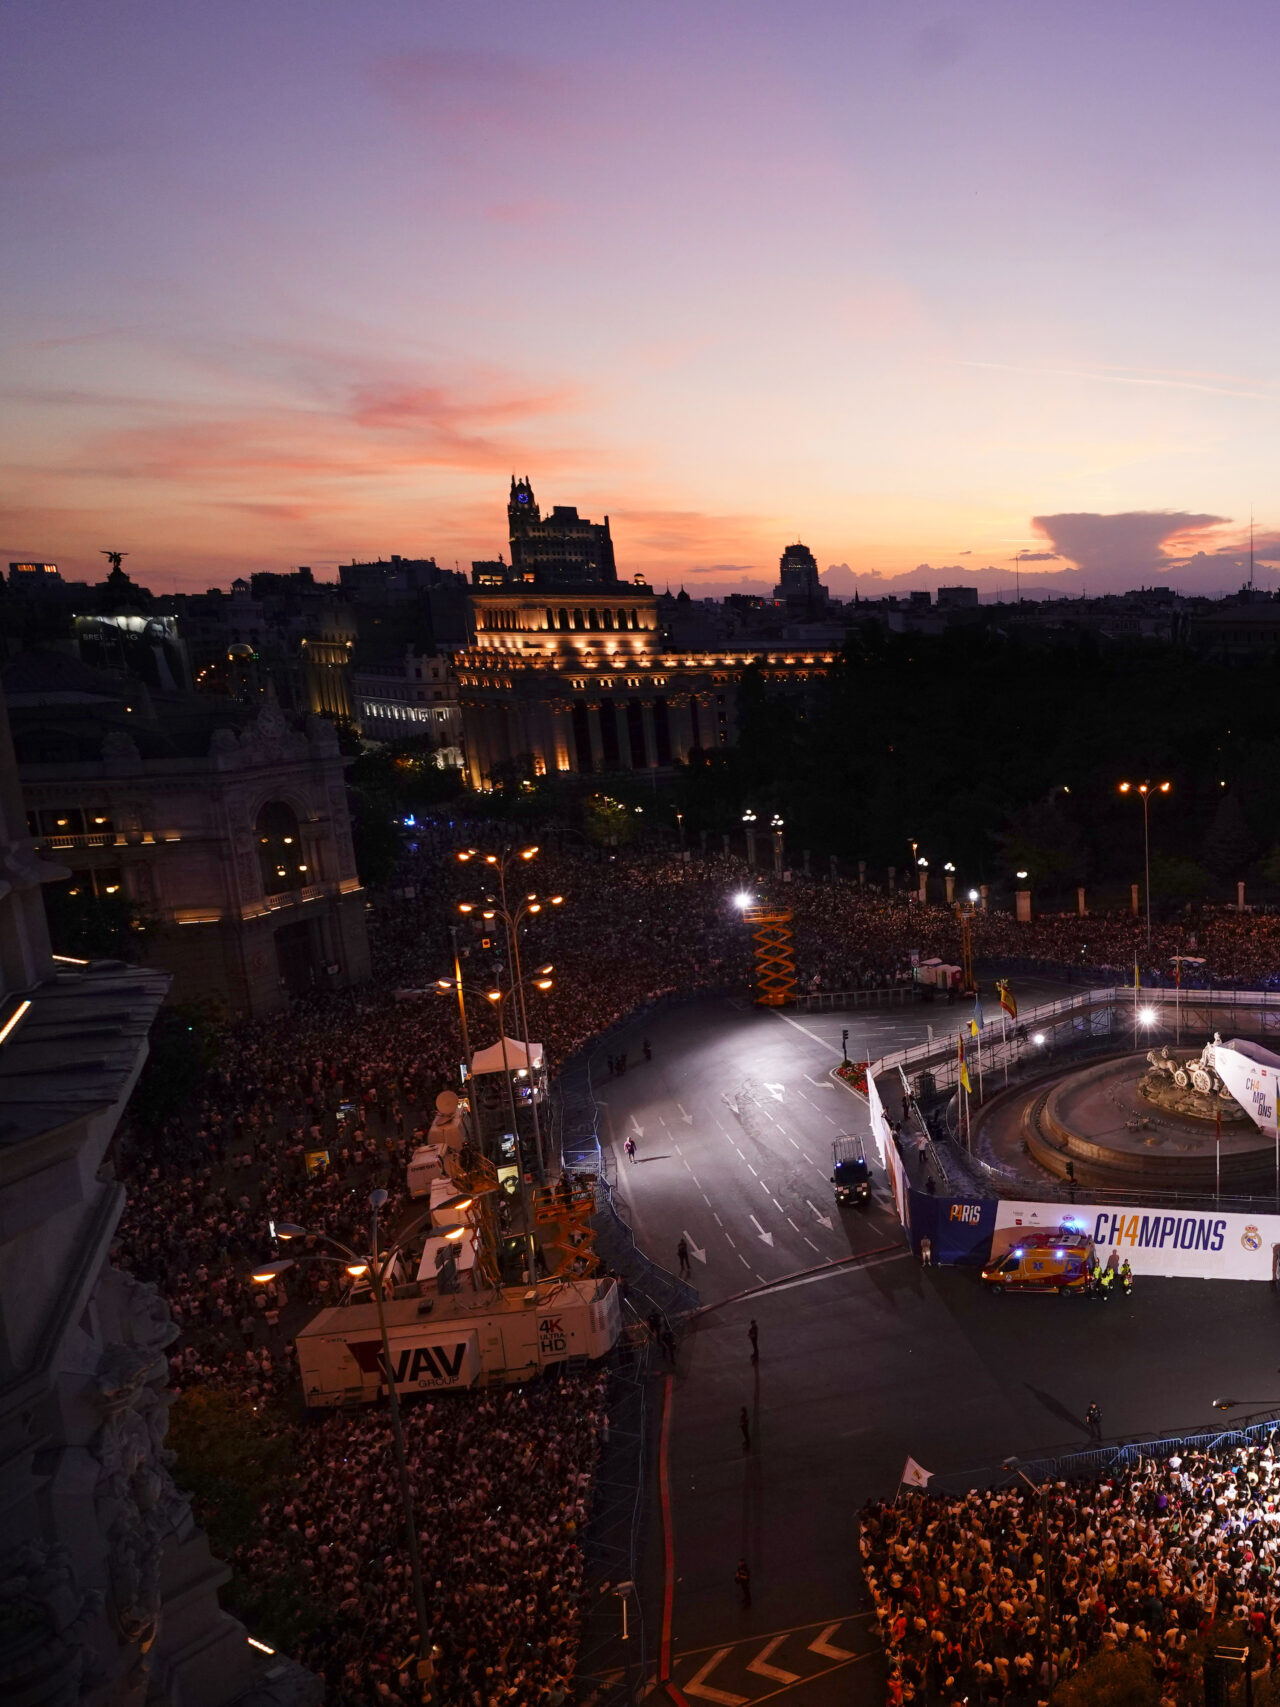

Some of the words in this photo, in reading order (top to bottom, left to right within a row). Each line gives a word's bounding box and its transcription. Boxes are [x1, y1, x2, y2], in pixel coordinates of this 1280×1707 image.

[1258, 1104, 1272, 1118] ONS
[539, 1318, 564, 1333] 4K
[541, 1339, 566, 1353] HD
[418, 1376, 460, 1389] GROUP
